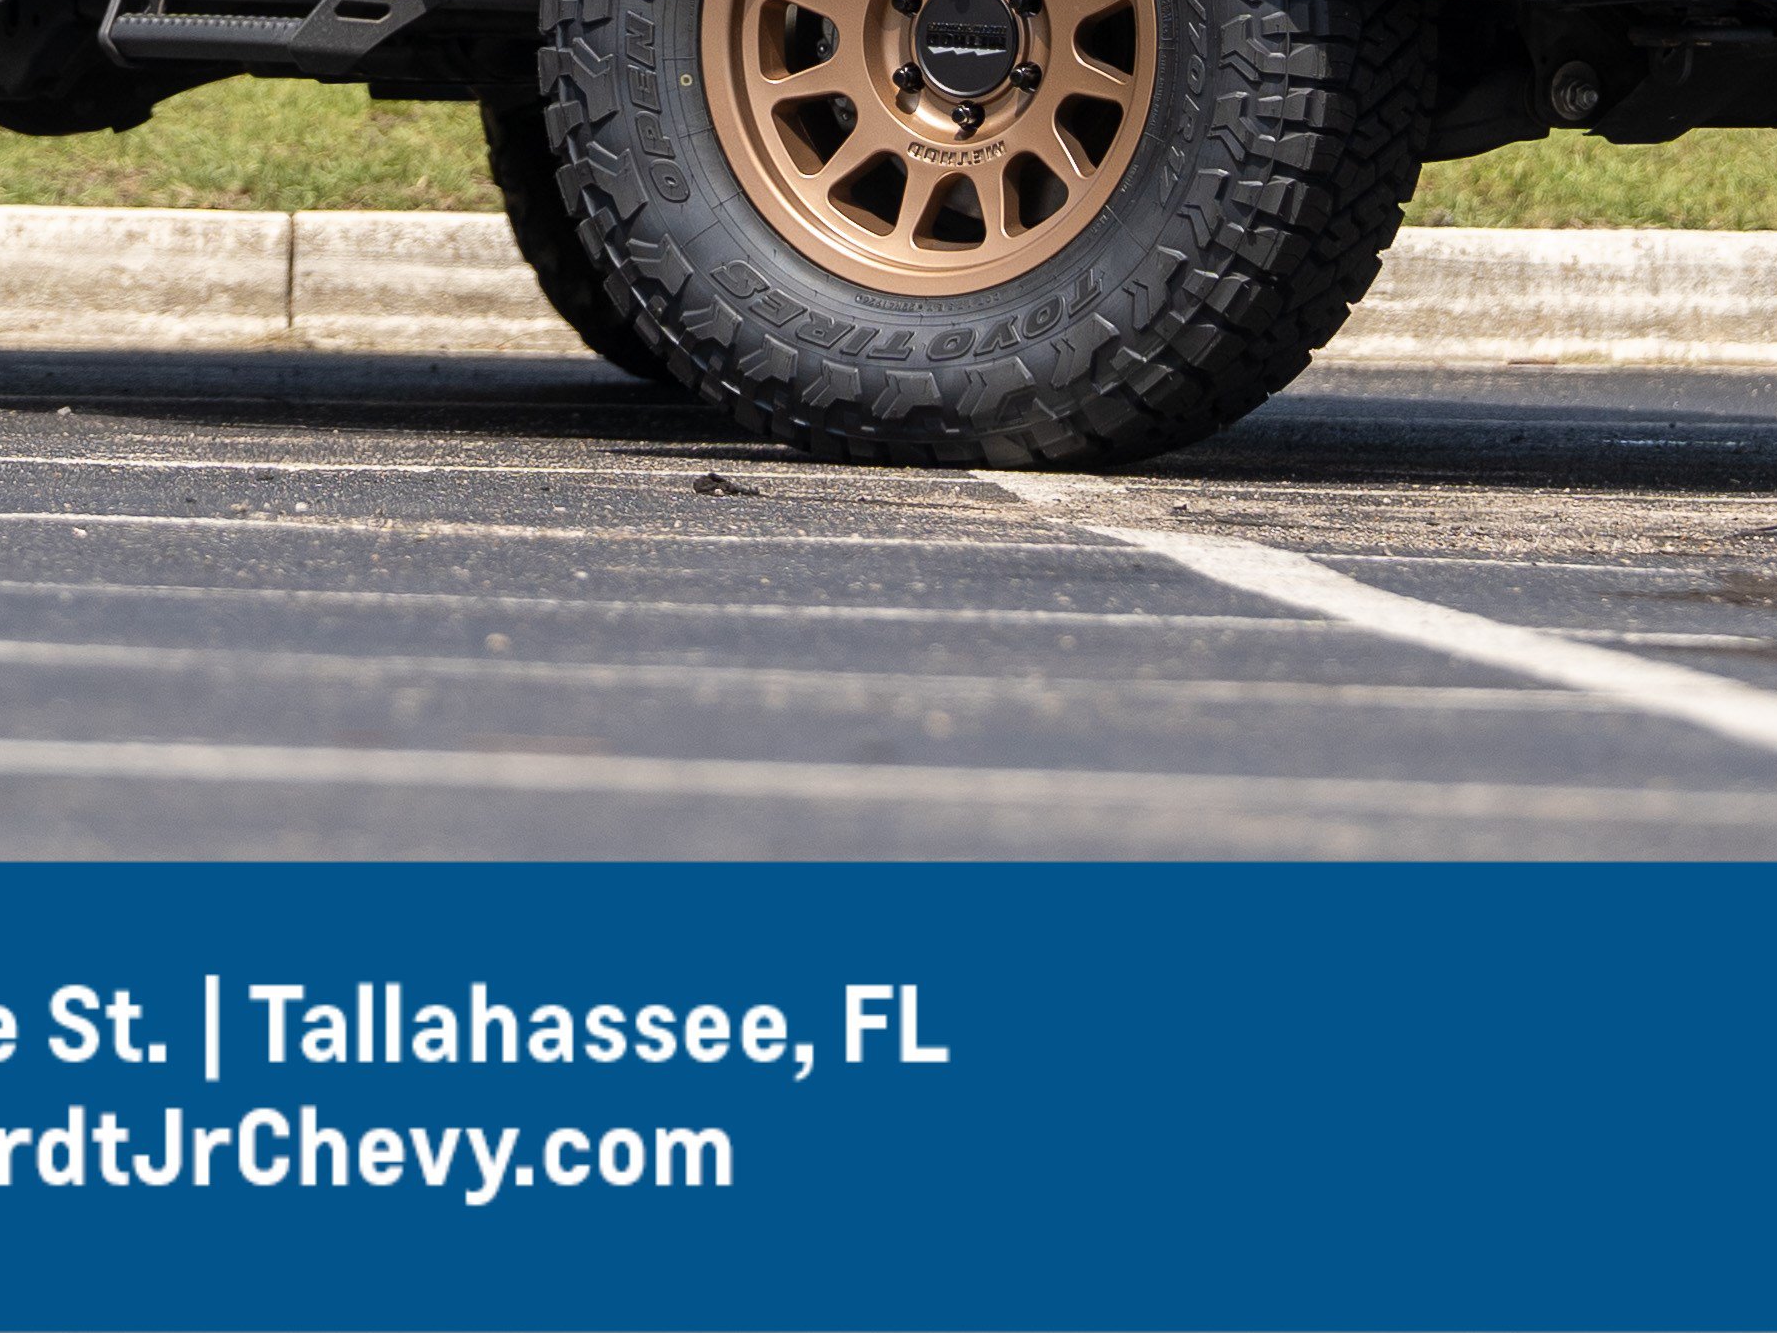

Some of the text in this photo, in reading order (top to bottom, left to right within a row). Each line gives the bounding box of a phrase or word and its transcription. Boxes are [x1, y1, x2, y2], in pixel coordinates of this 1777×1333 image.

[625, 10, 691, 204] OPEN
[907, 140, 1008, 167] METHOD
[710, 259, 1105, 362] TOYO TIRES
